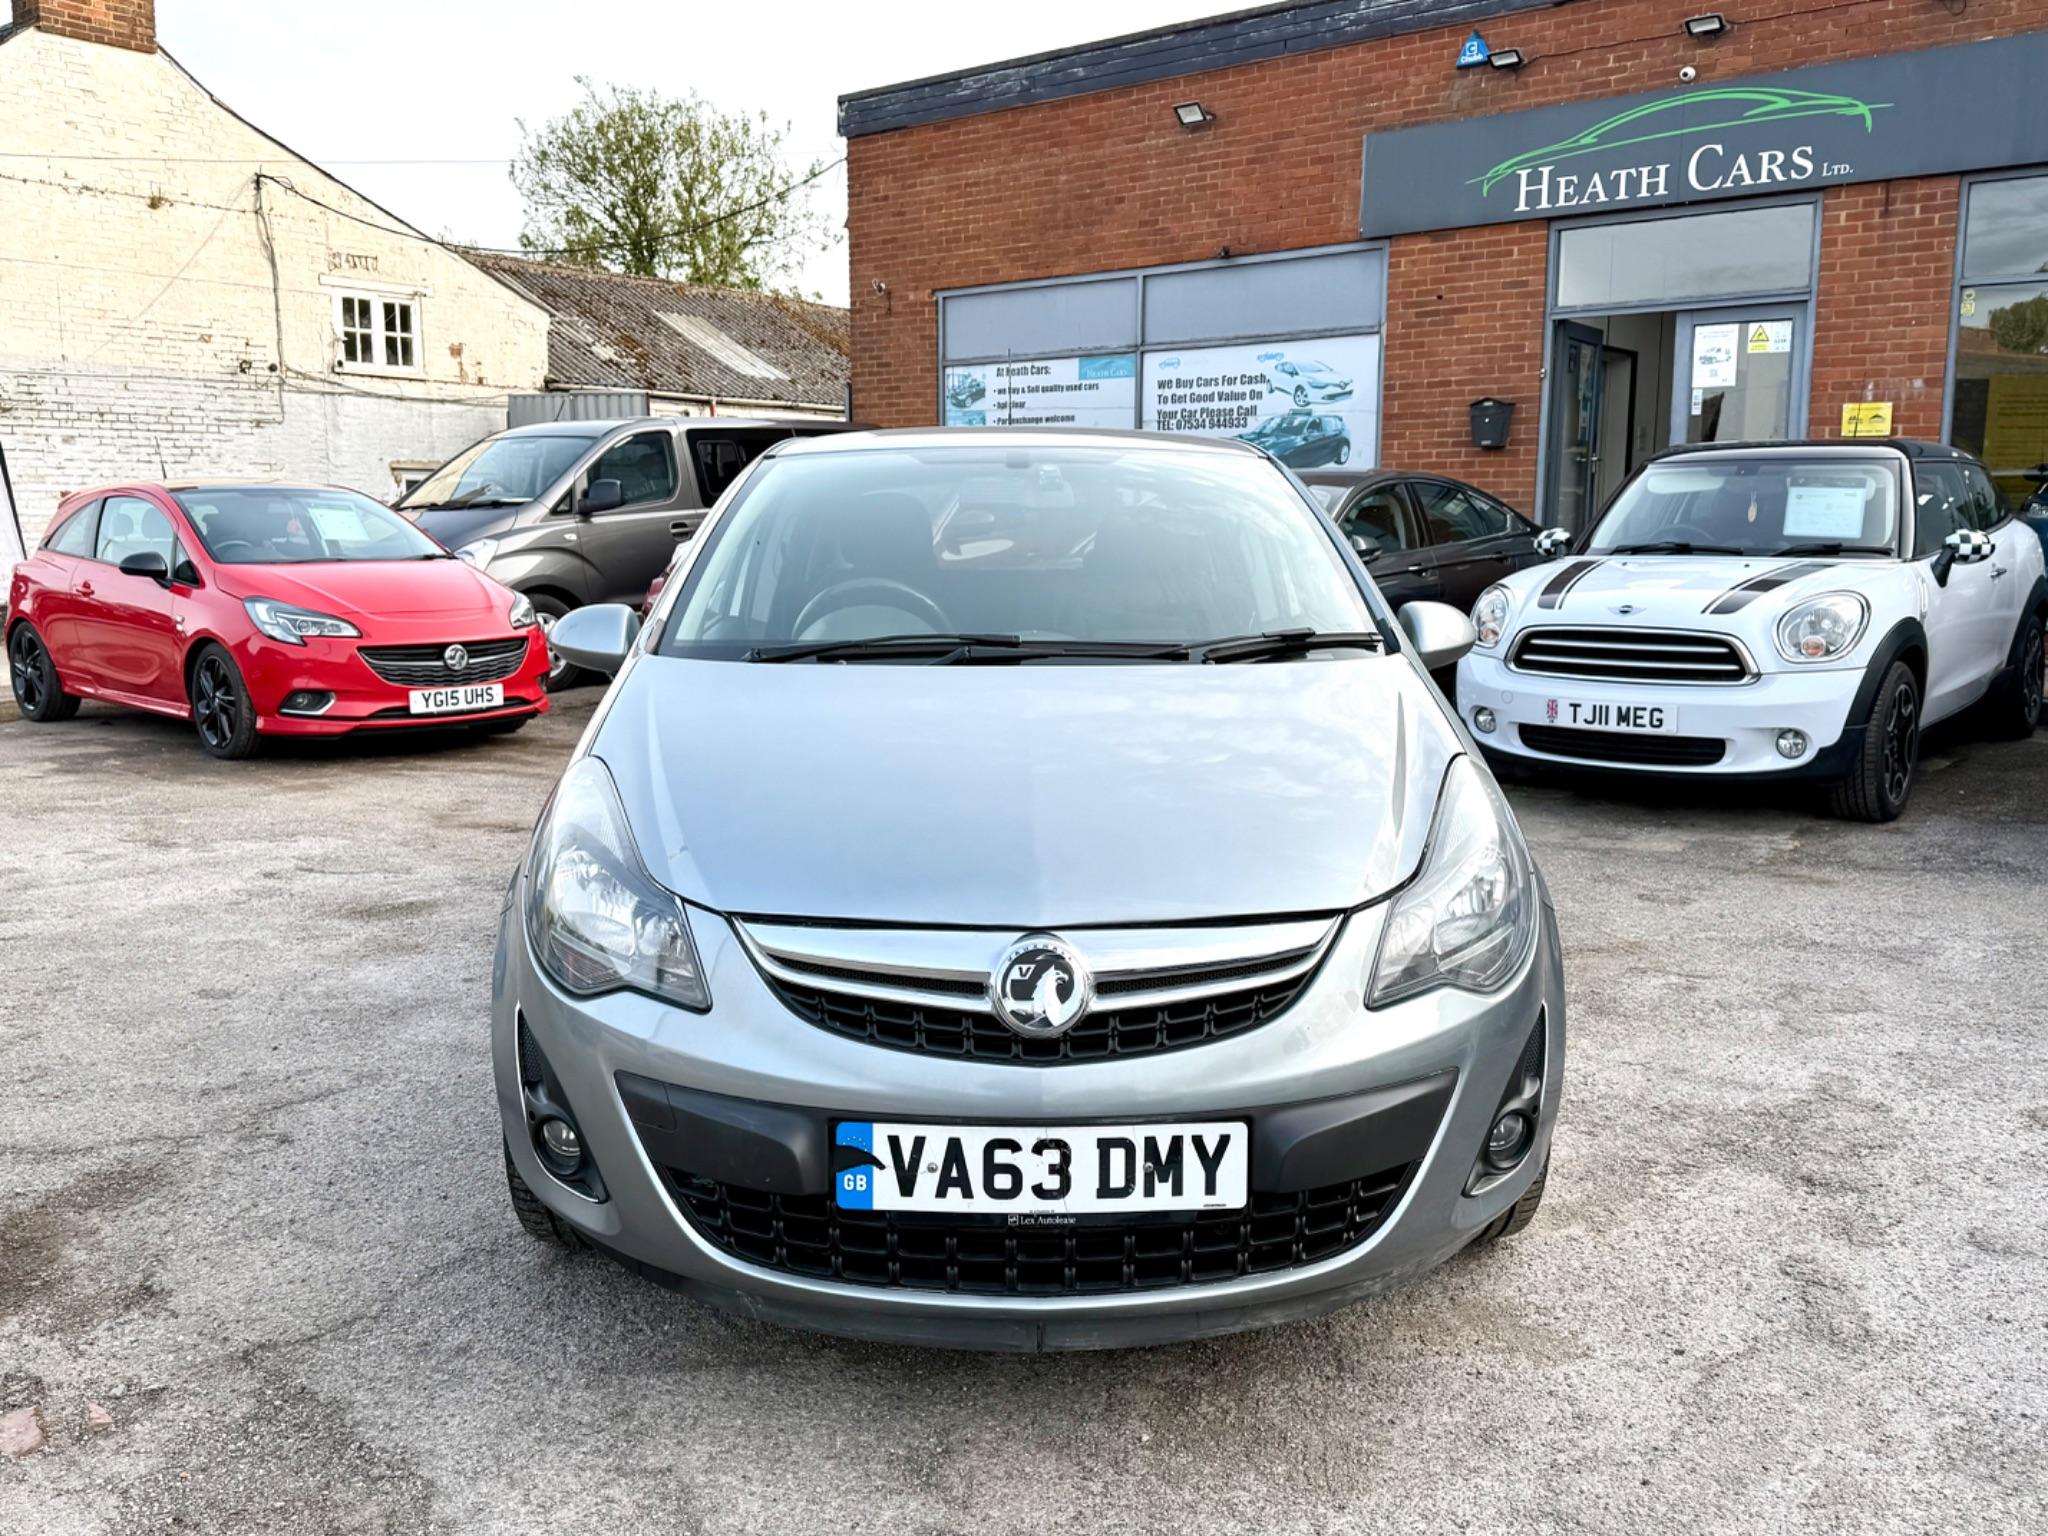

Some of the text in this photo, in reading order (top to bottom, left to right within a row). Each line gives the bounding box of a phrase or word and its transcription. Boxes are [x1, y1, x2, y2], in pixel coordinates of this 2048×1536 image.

[1041, 383, 1064, 393] quality
[1065, 383, 1083, 392] used
[1083, 383, 1099, 391] cars
[1175, 378, 1194, 389] Buy
[1196, 376, 1220, 388] Cars
[1221, 375, 1238, 386] For
[1157, 389, 1263, 405] To Get Good Value On
[1157, 405, 1257, 420] Your Car Please Call
[1157, 417, 1248, 431] TEL: 07534 944933
[465, 687, 494, 705] UHS
[1616, 706, 1664, 729] MEG
[887, 1134, 1232, 1200] VA63 DMY
[844, 1174, 867, 1191] GB
